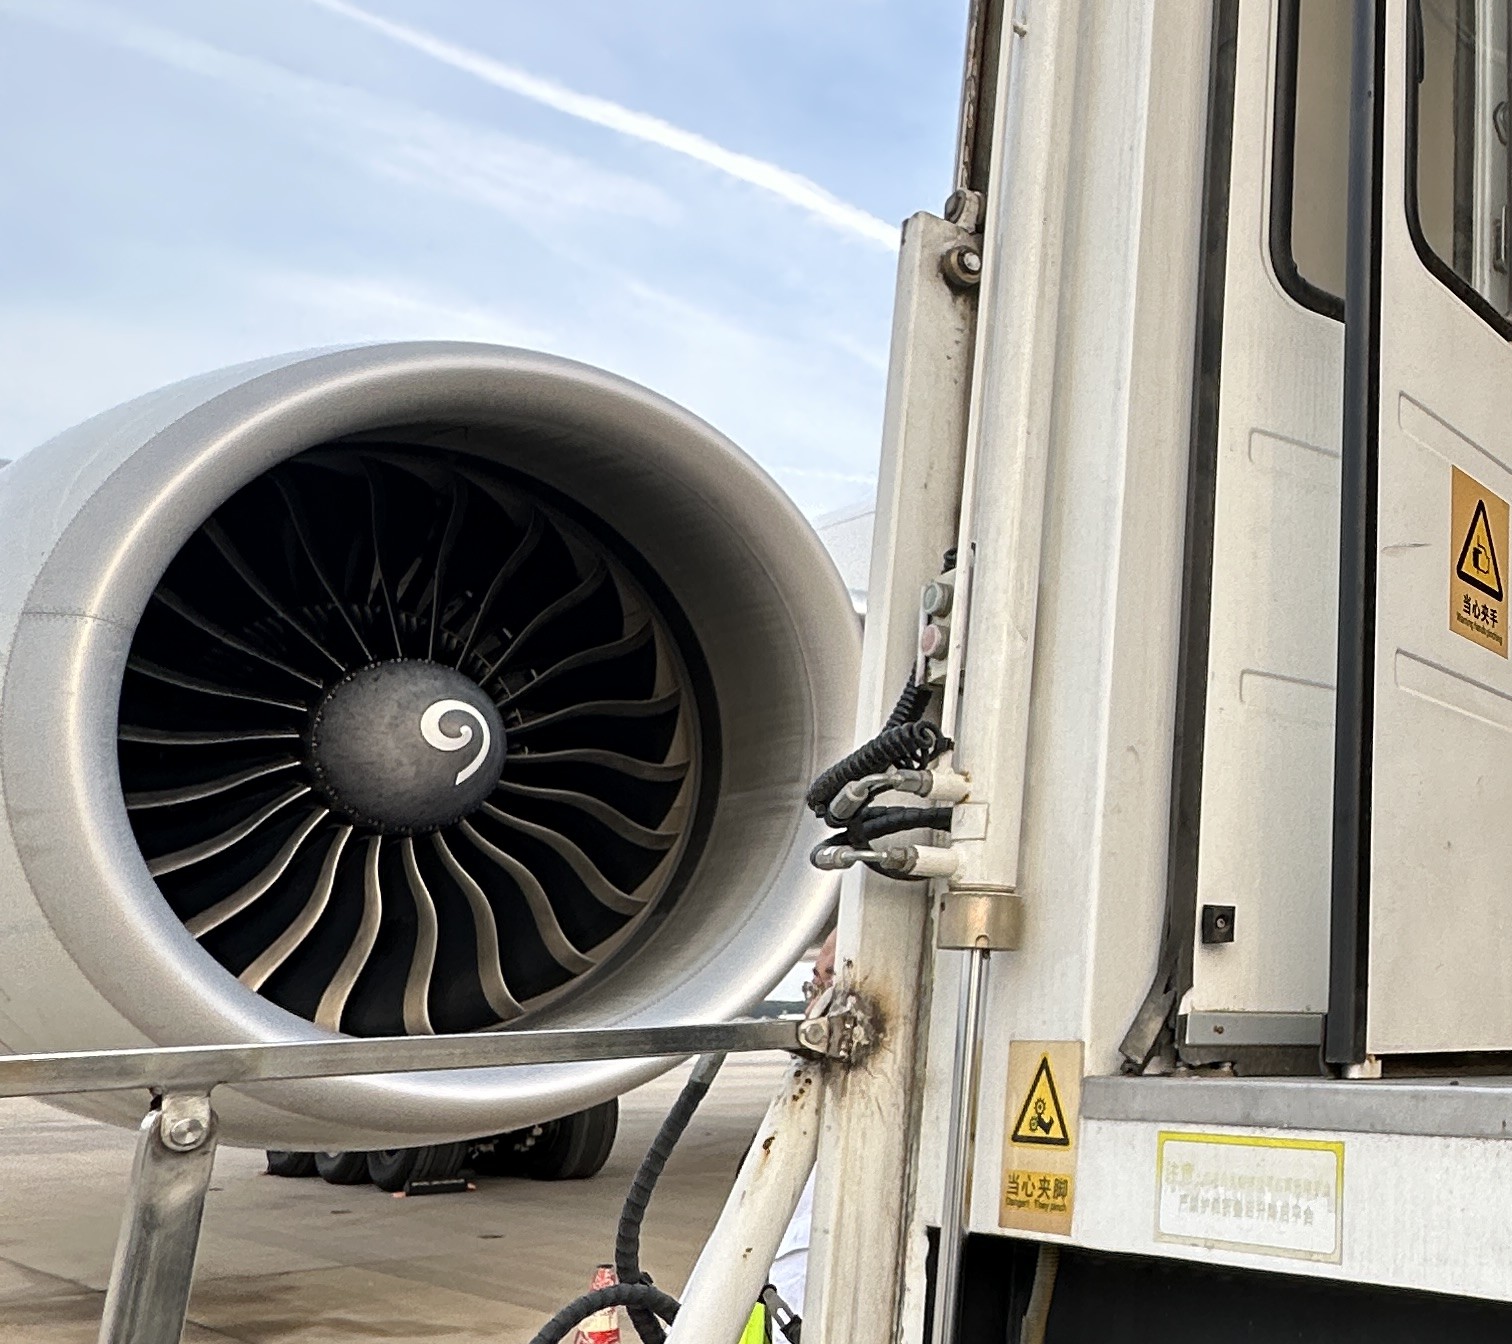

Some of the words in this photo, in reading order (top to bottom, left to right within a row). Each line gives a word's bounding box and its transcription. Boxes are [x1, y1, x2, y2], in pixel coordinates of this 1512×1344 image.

[1462, 593, 1499, 629] 当心夹手
[1006, 1172, 1069, 1201] 当心夹脚
